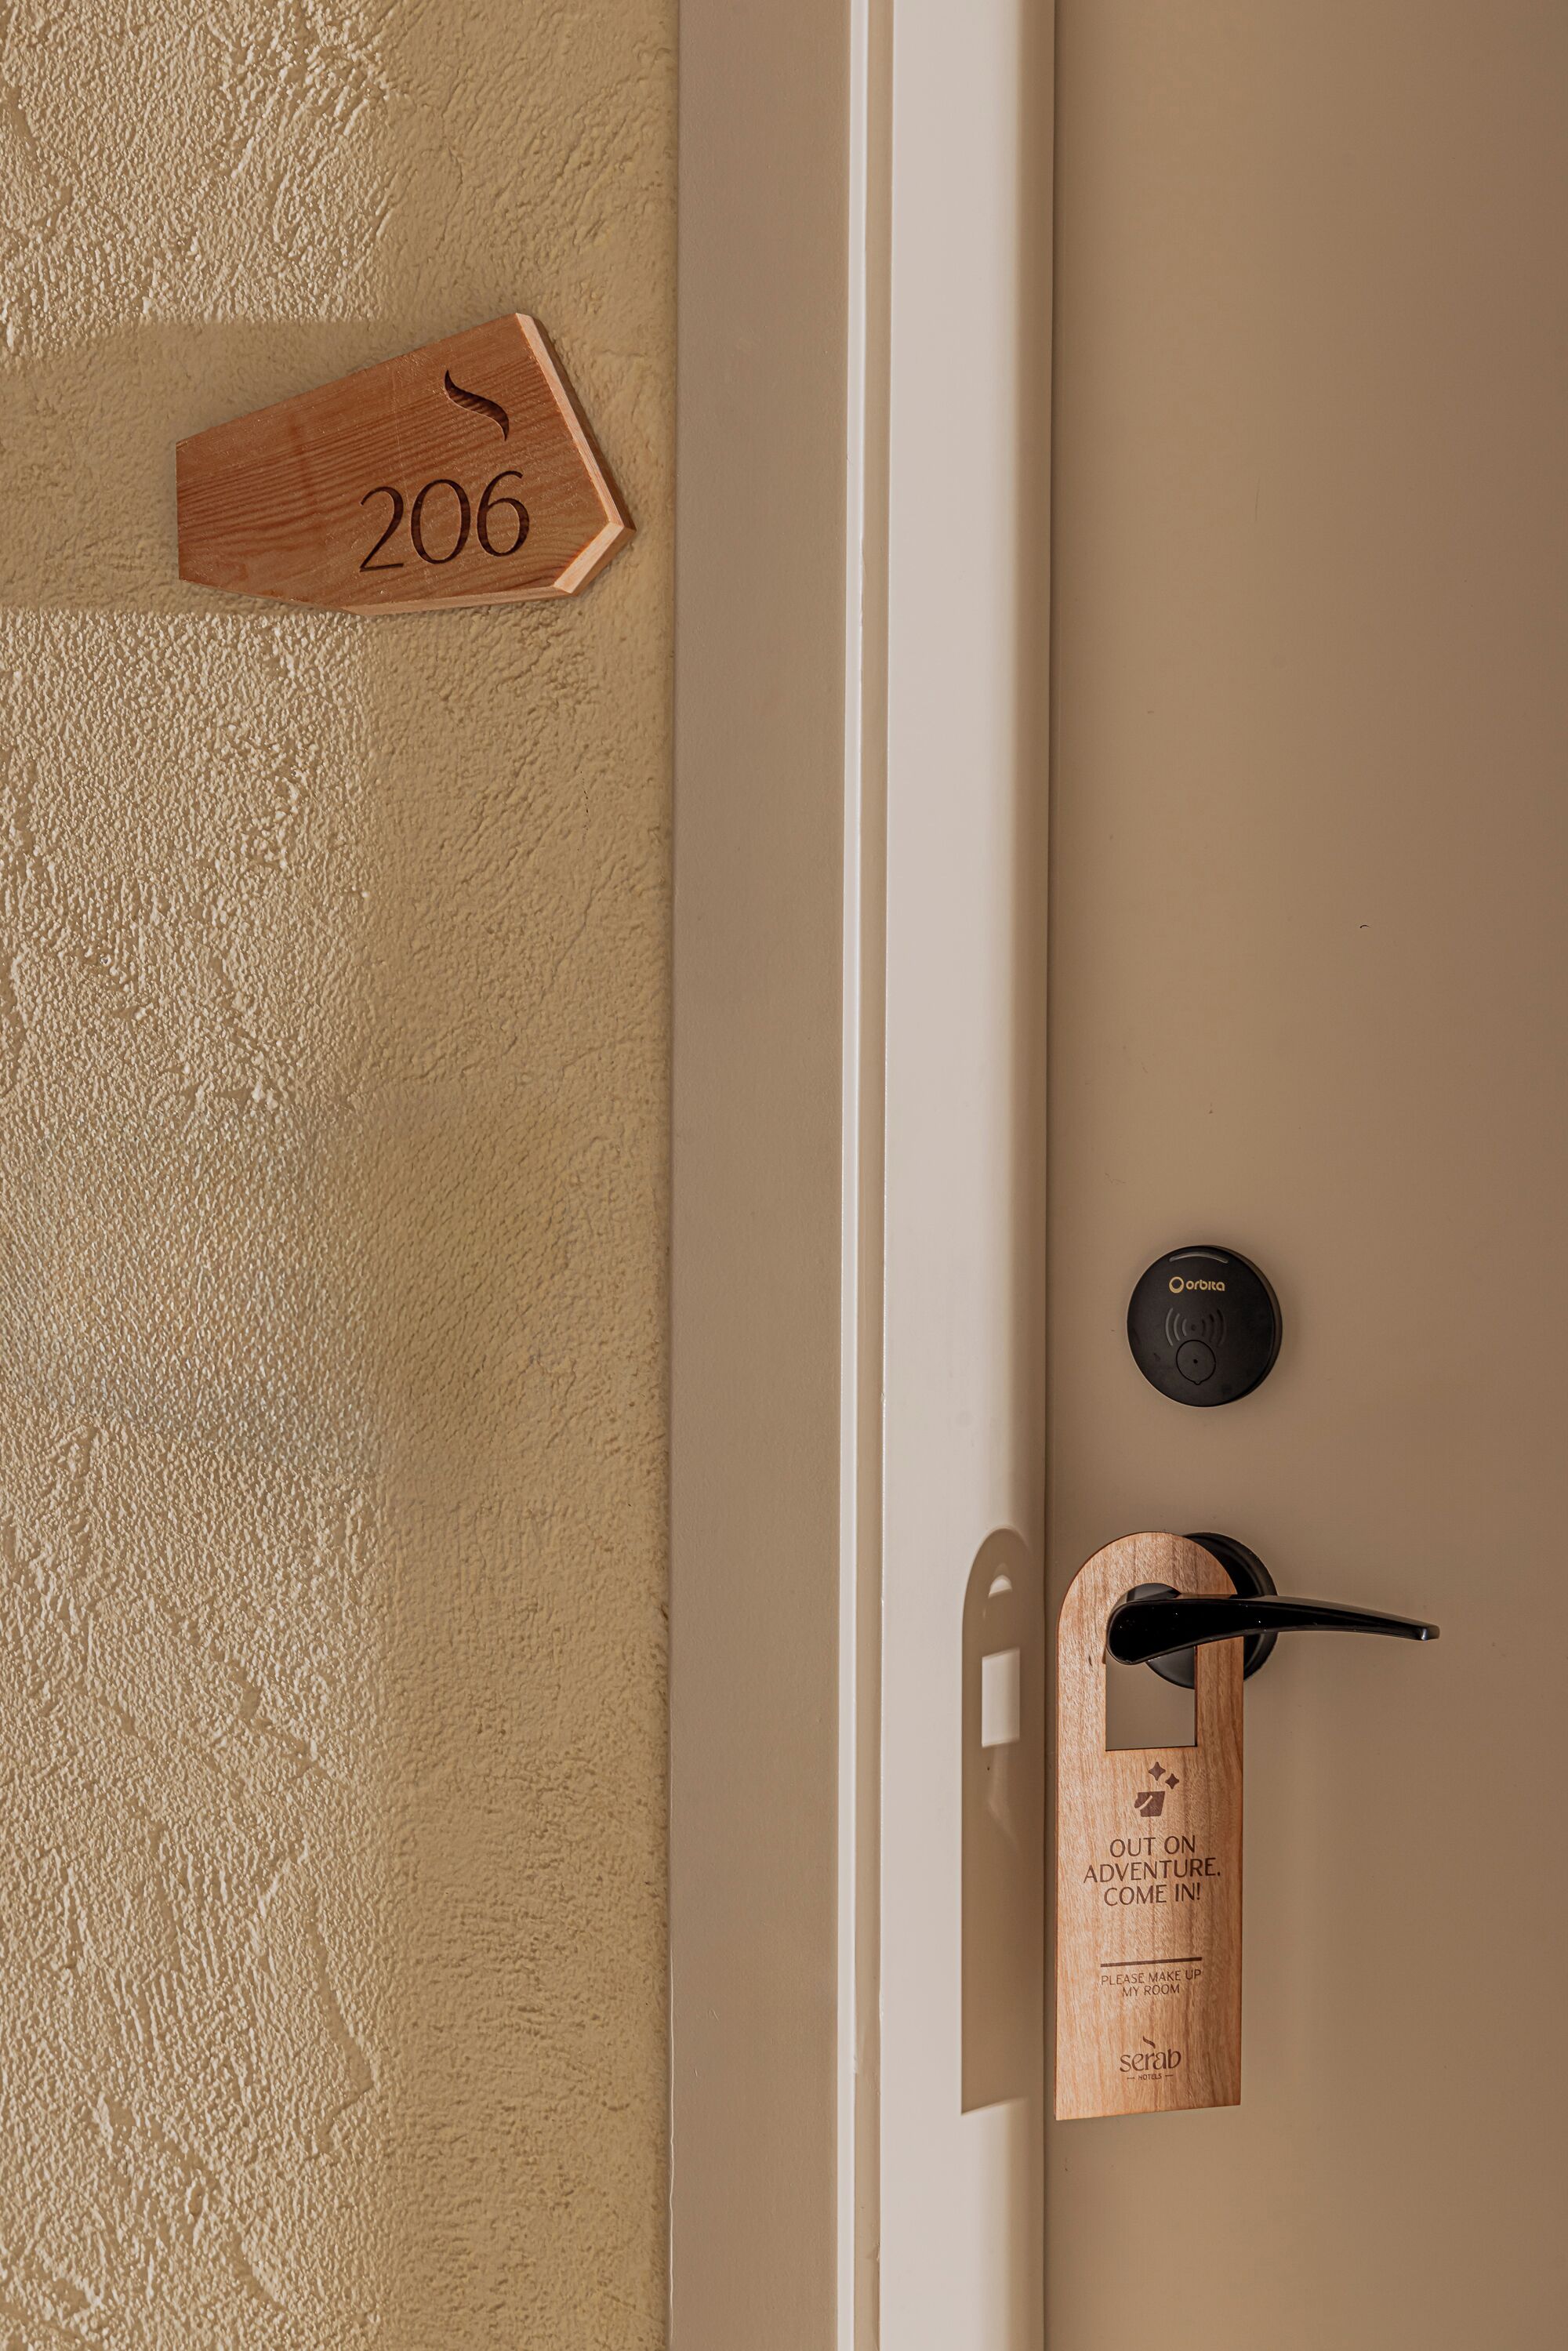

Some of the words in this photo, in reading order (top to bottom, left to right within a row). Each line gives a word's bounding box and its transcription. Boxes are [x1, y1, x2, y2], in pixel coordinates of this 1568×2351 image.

[360, 470, 530, 572] 206
[1109, 1837, 1156, 1858] OUT
[1163, 1835, 1196, 1855] ON
[1083, 1857, 1221, 1883] ADVENTURE.
[1104, 1884, 1167, 1906] COME
[1175, 1882, 1200, 1902] IN!
[1101, 1972, 1145, 1986] PLEASE
[1148, 1970, 1181, 1983] MAKE
[1185, 1969, 1202, 1980] UP
[1122, 1986, 1139, 1997] MY
[1144, 1983, 1180, 1995] ROOM
